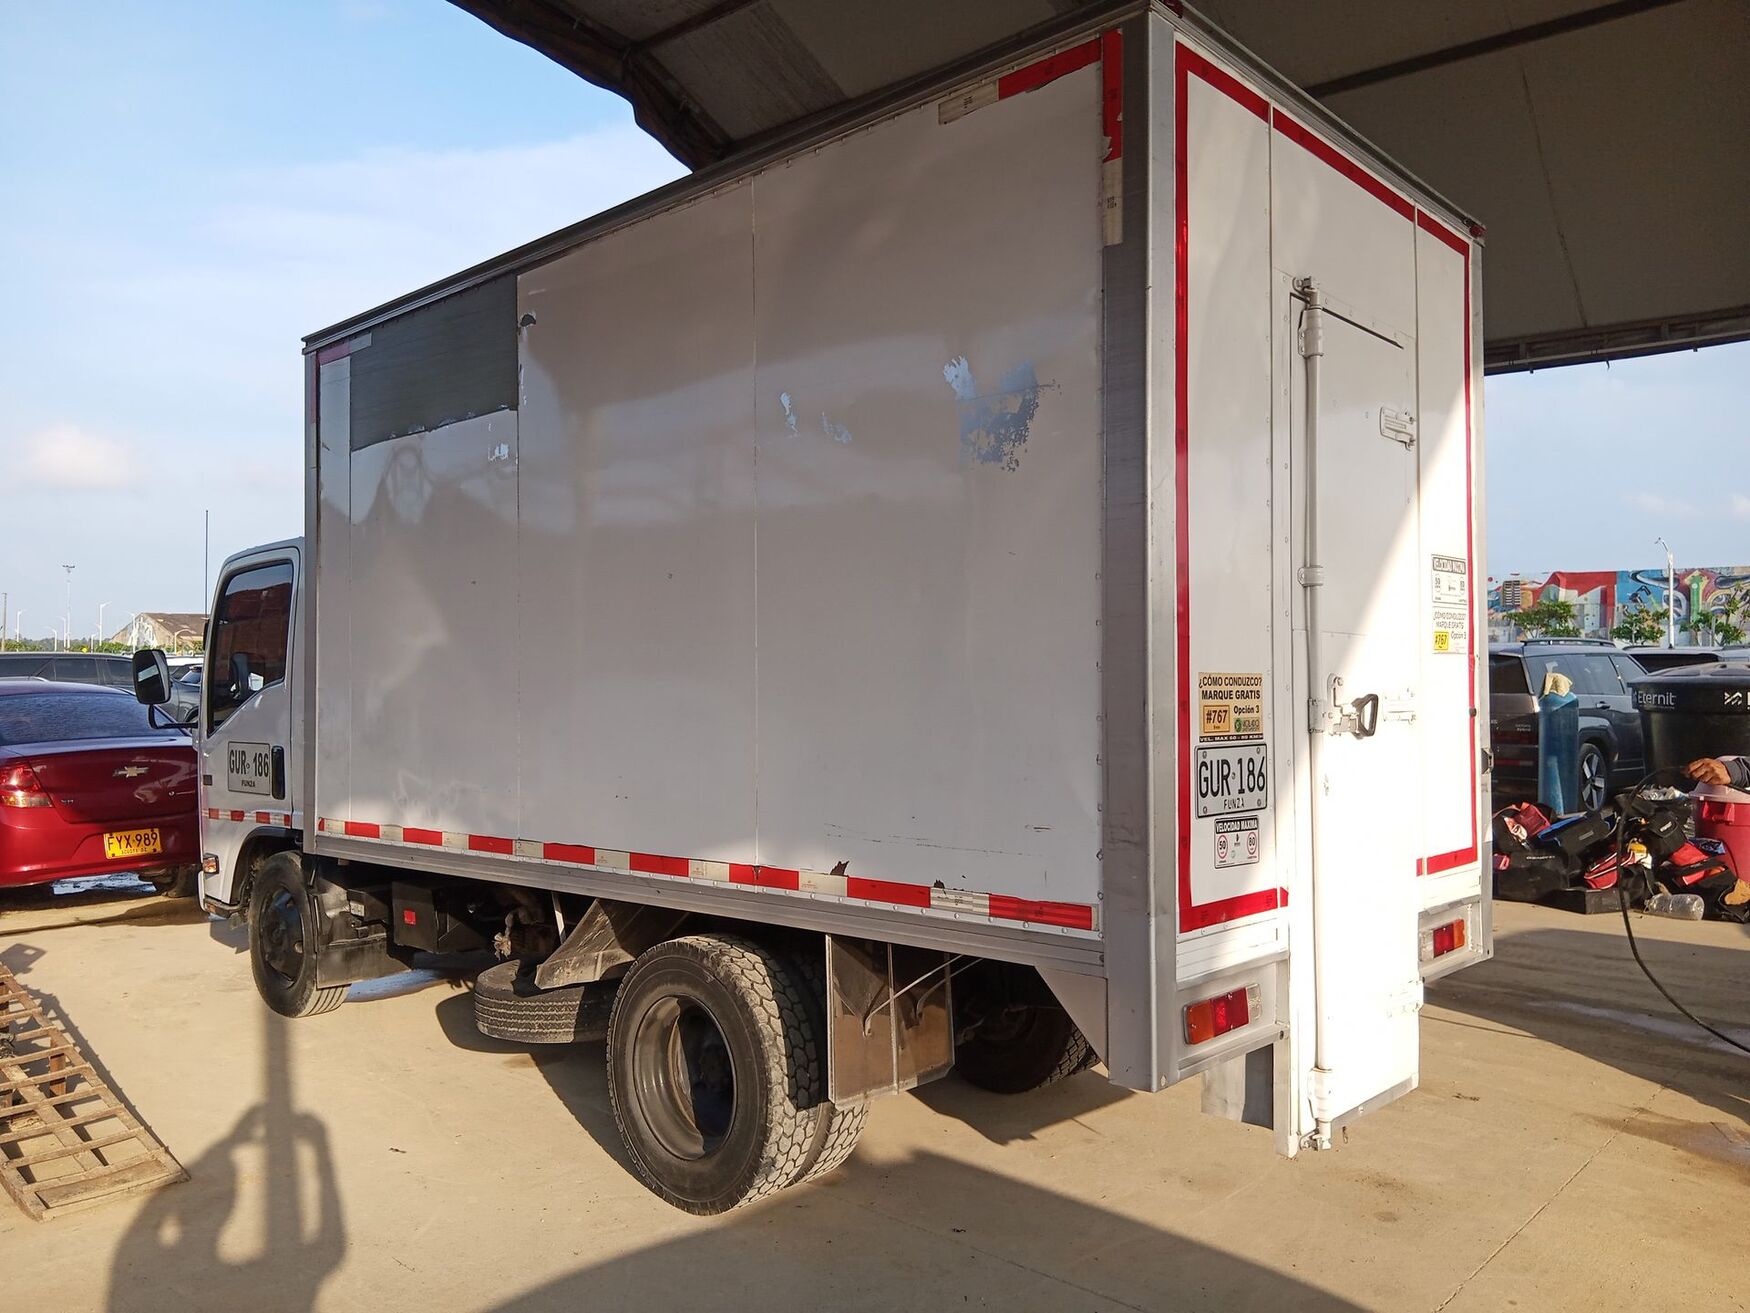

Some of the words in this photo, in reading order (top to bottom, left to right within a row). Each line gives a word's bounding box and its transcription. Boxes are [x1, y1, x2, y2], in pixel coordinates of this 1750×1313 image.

[1199, 674, 1223, 689] ¿CÓMO
[1224, 676, 1262, 687] CONDUZCO?
[1201, 689, 1233, 700] MARQUE
[1235, 689, 1261, 700] GRATIS
[1638, 691, 1677, 705] Eternit
[1255, 704, 1260, 714] 3
[1206, 709, 1228, 724] #767
[230, 749, 247, 775] GUR
[253, 752, 269, 778] 186
[1199, 759, 1231, 798] GUR
[1237, 756, 1265, 793] 186
[1223, 797, 1245, 810] FUNZA
[107, 834, 132, 851] FYX
[135, 831, 158, 848] 989
[1219, 840, 1227, 850] 50
